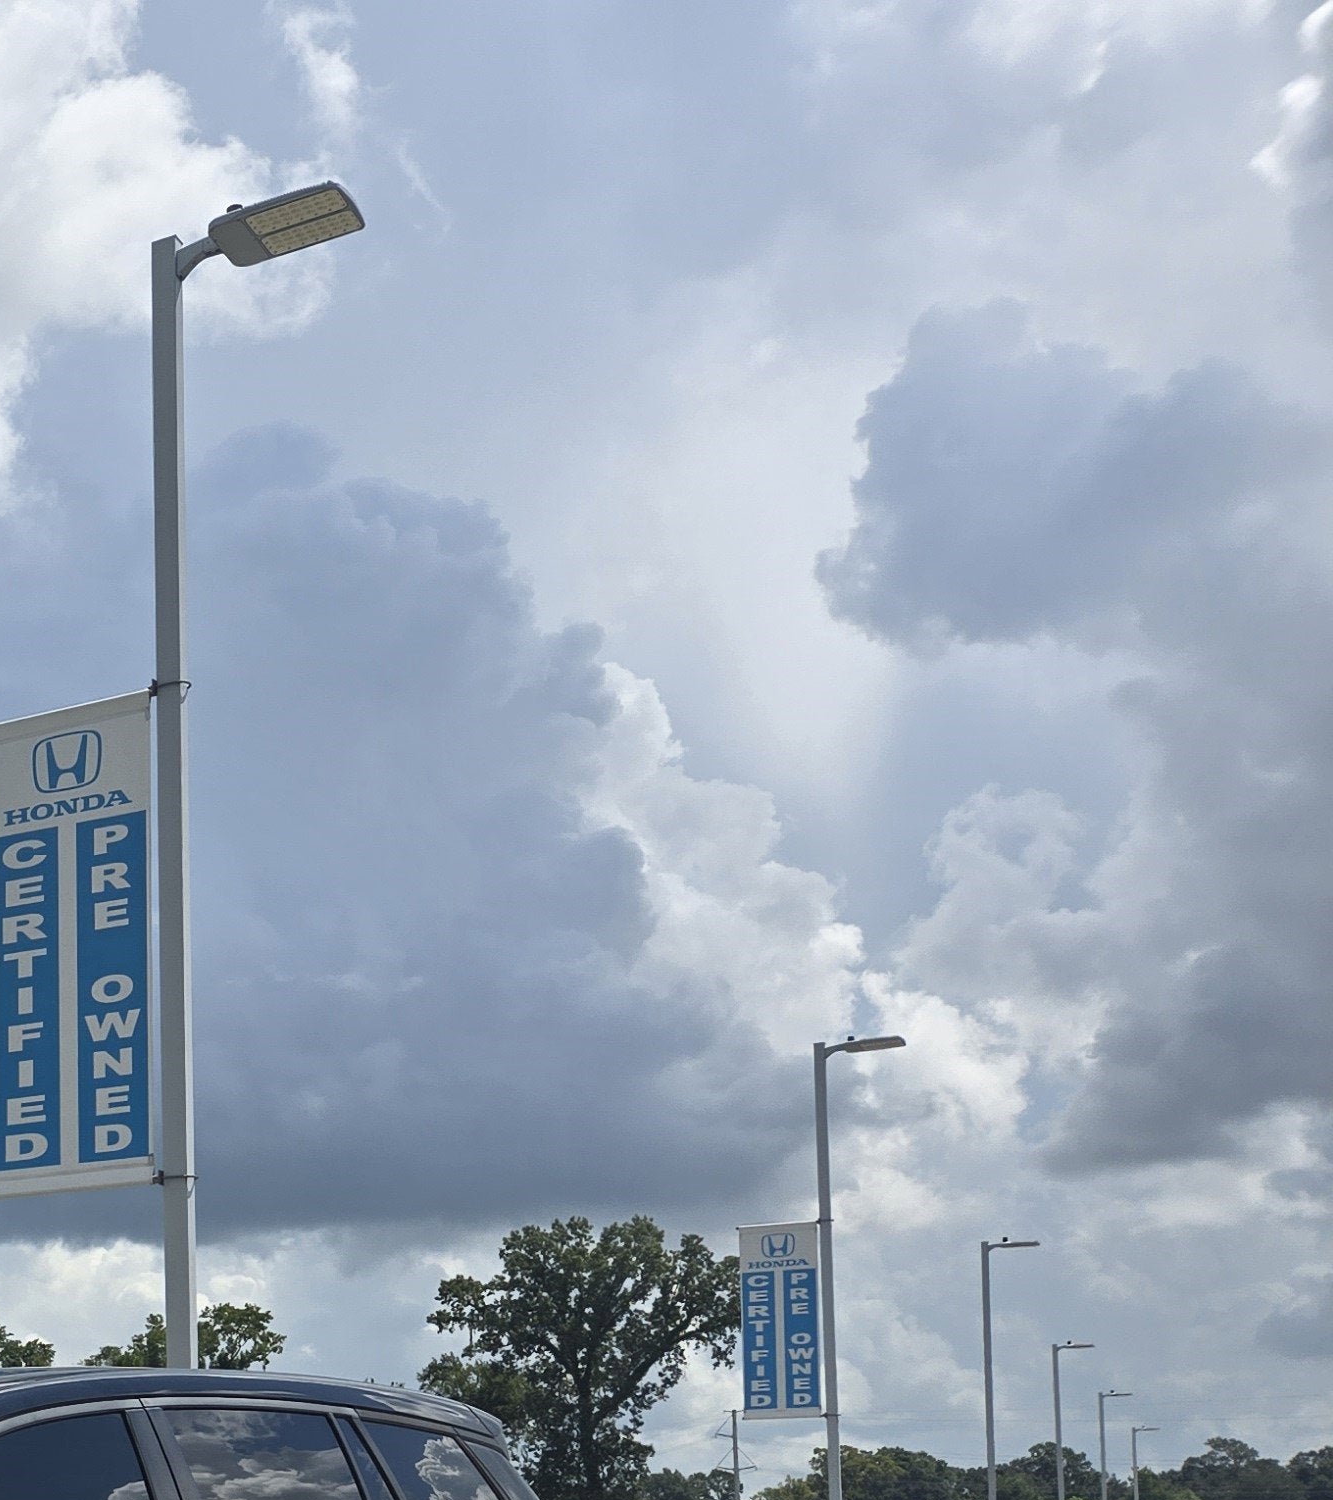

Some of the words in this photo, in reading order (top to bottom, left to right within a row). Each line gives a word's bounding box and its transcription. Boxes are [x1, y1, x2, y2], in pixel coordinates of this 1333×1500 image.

[3, 789, 132, 827] HONDA
[90, 824, 131, 931] PRE
[1, 839, 49, 1164] CERTIFIED
[85, 973, 141, 1154] OWNED
[748, 1259, 809, 1270] HONDA
[789, 1272, 810, 1316] PRE
[746, 1275, 773, 1408] CERTIFIED
[788, 1332, 815, 1406] OWNED
